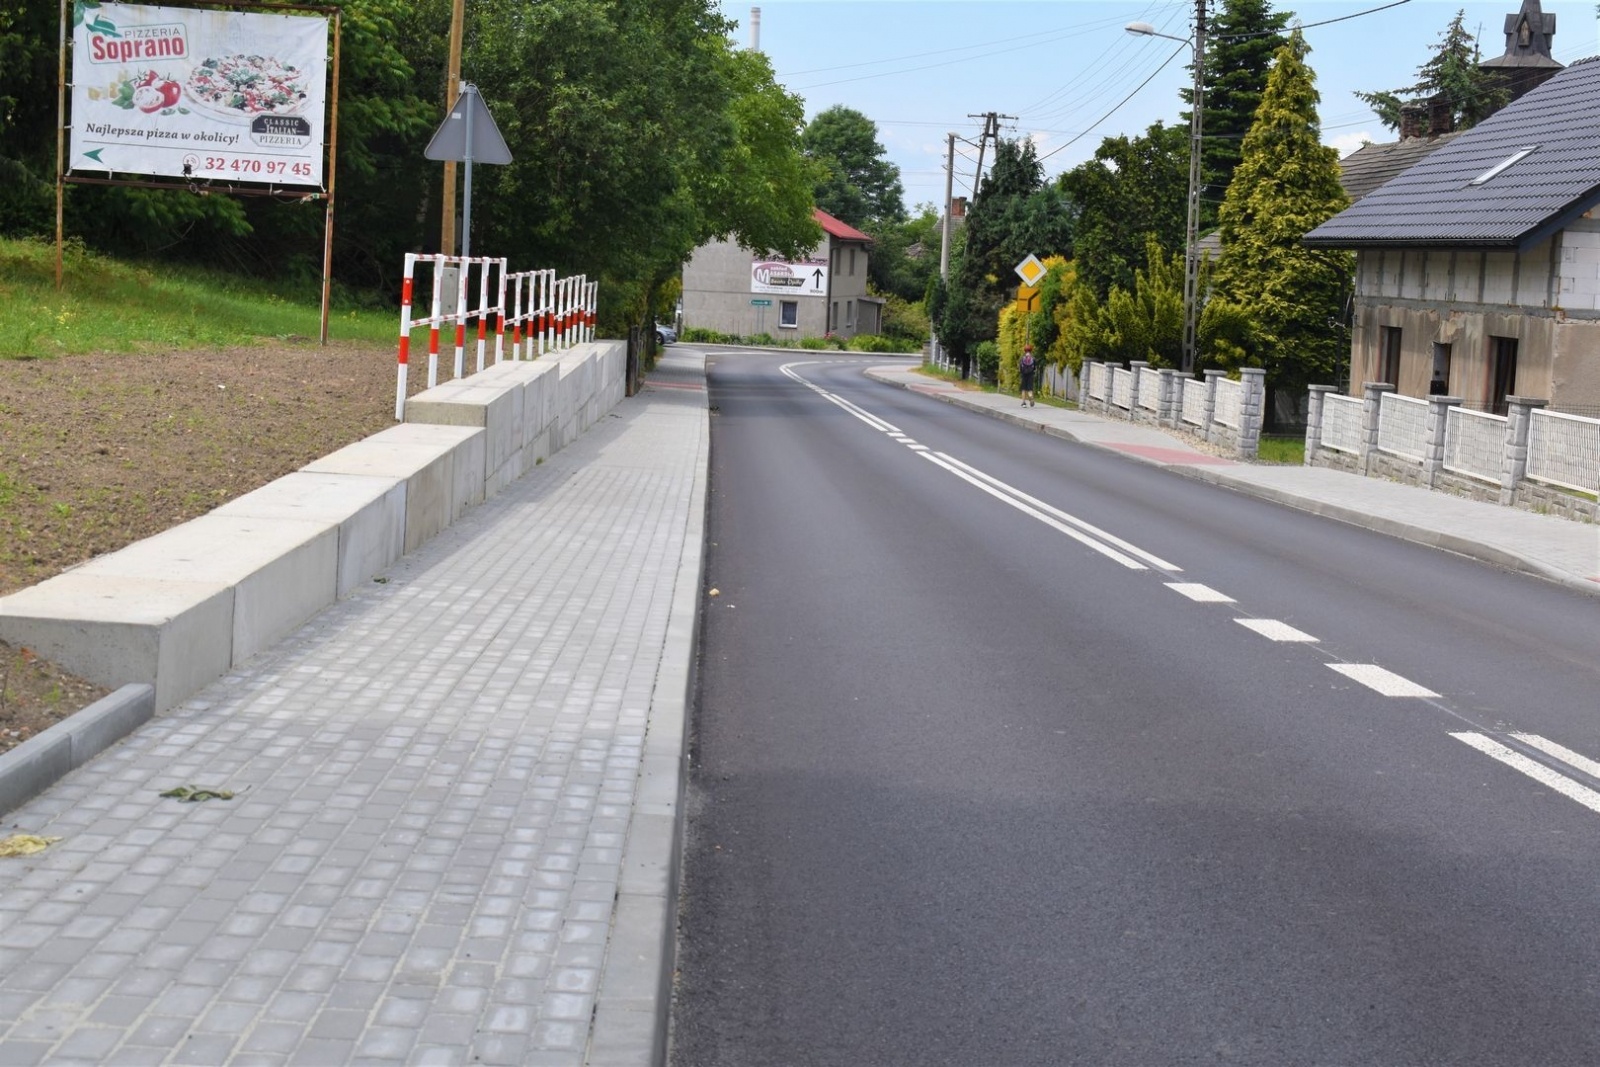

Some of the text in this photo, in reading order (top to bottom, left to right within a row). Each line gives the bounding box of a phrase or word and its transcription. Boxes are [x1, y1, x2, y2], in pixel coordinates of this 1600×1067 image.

[124, 27, 181, 38] PIZZERIA
[91, 35, 185, 63] Soprano
[263, 118, 299, 126] CLASSIC
[85, 123, 240, 144] Najlepsza pizza w okolicy!
[259, 135, 302, 145] PIZZERIA
[205, 157, 311, 176] 32 470 97 45
